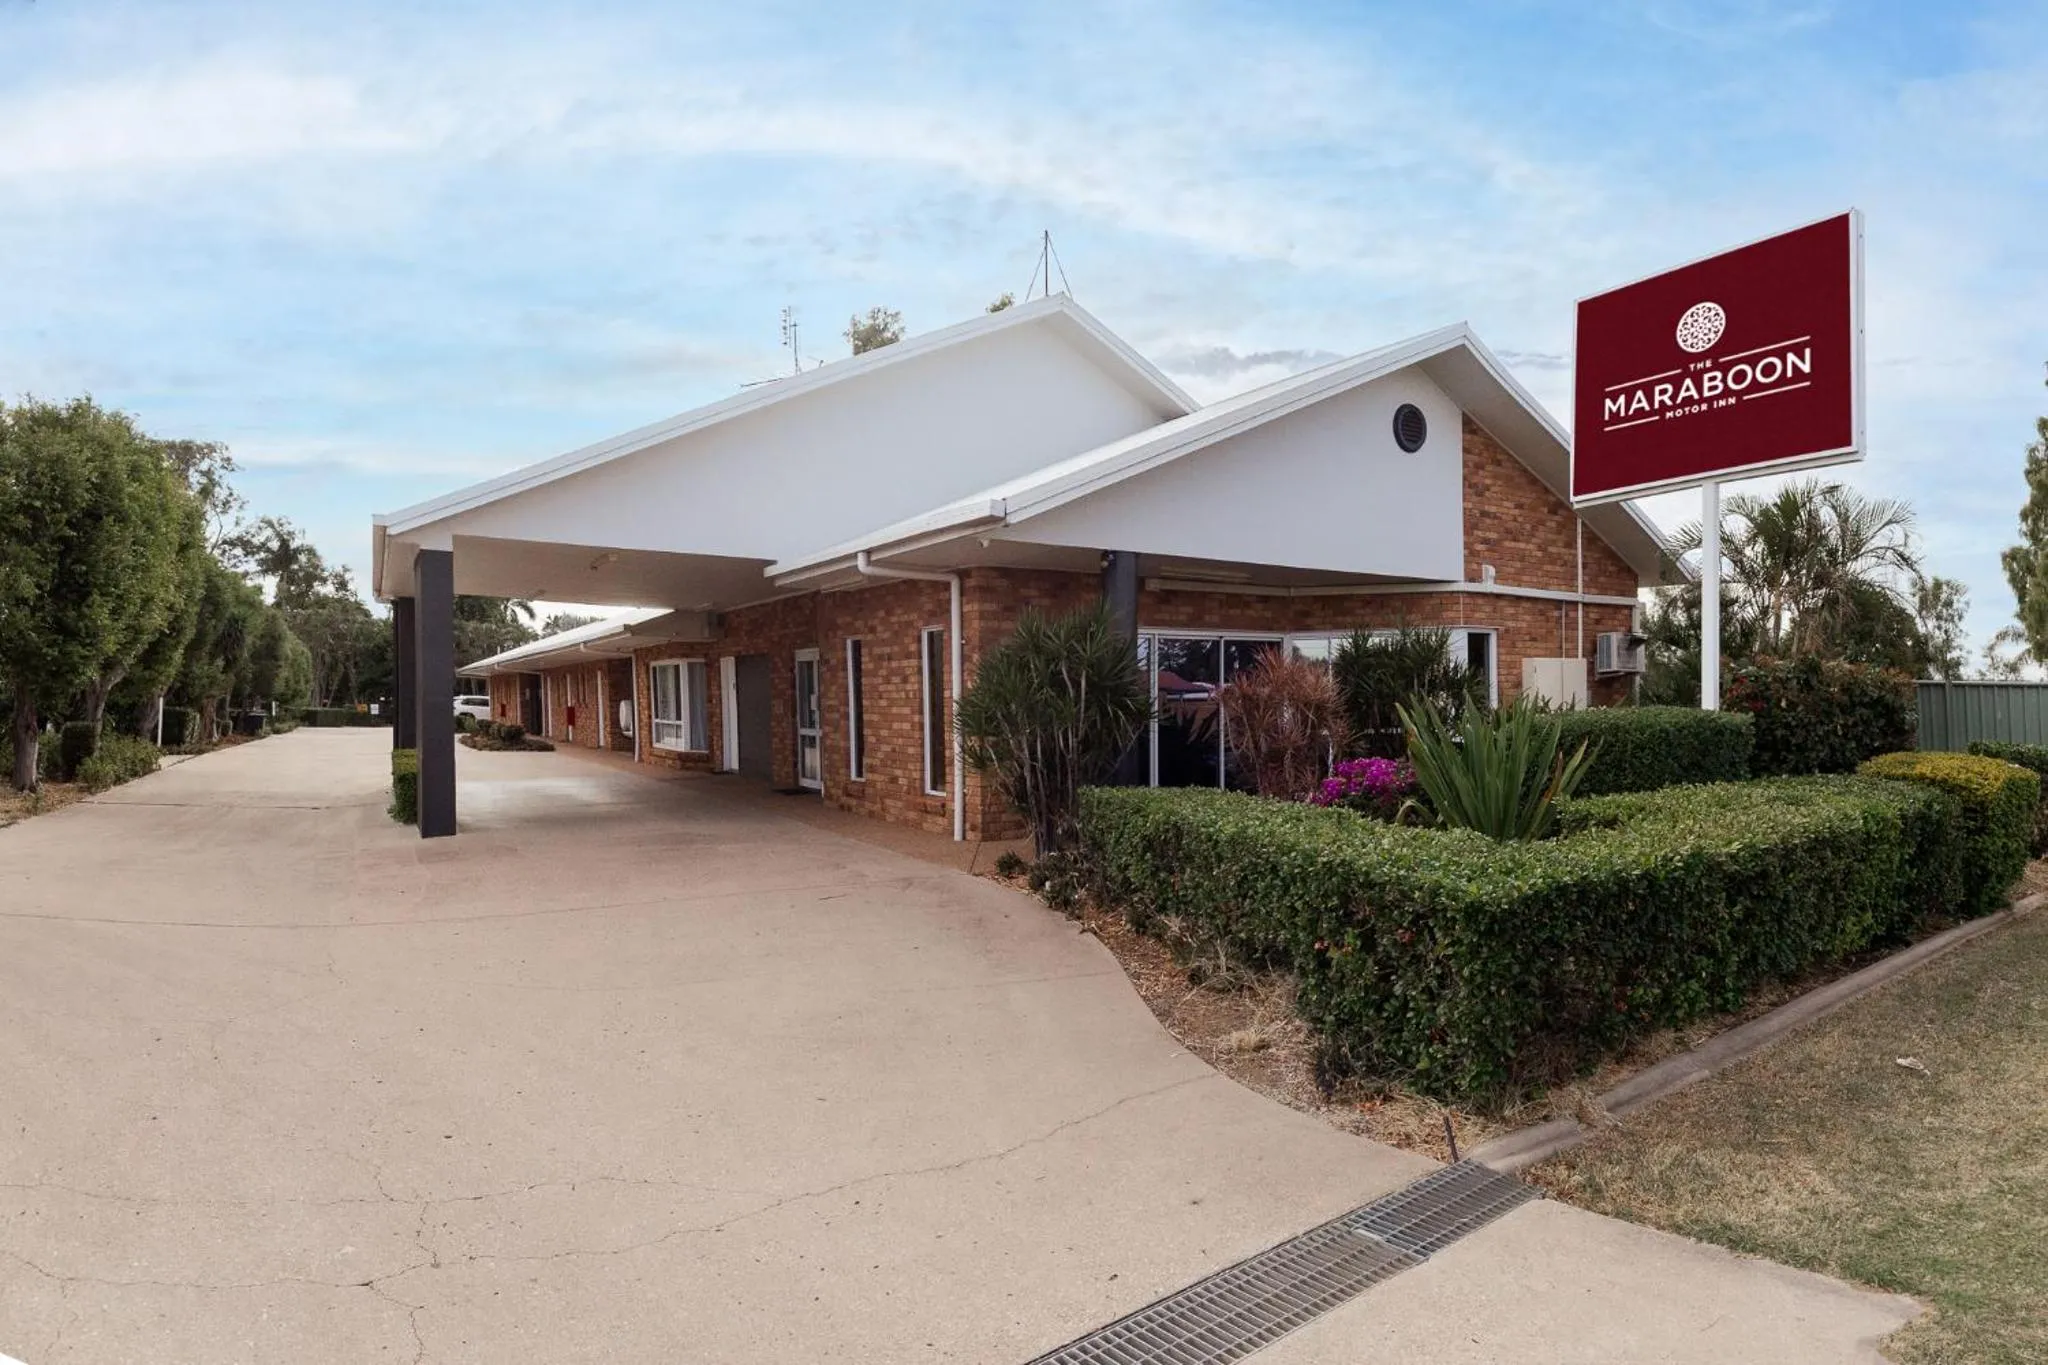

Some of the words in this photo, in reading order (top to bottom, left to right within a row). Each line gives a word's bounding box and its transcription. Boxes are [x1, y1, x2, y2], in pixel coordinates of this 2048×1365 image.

[1689, 359, 1713, 372] THE
[1604, 348, 1811, 421] MARABOON
[1665, 403, 1708, 419] MOTOR
[1713, 397, 1736, 409] INN
